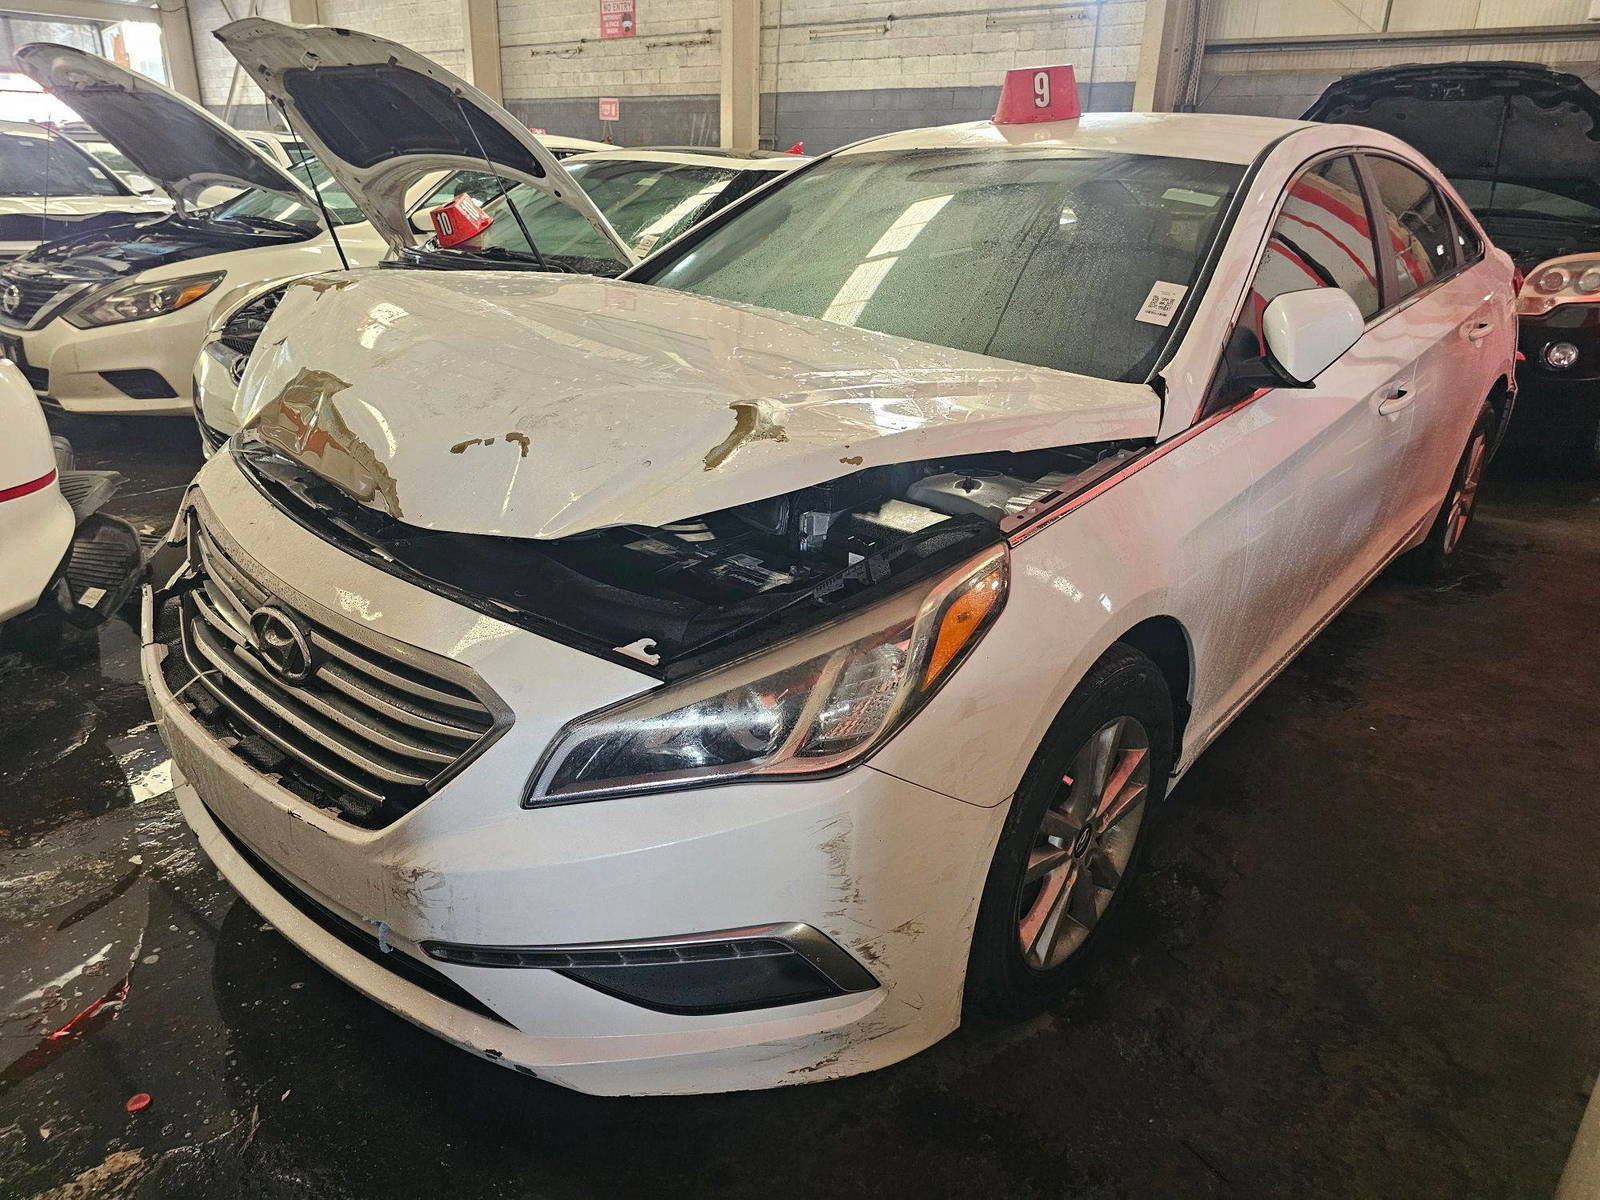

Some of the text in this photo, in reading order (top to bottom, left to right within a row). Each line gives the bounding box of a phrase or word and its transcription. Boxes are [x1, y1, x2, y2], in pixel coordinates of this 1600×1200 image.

[603, 2, 631, 12] NO ENTRY
[1034, 71, 1050, 108] 9
[437, 211, 453, 236] 10
